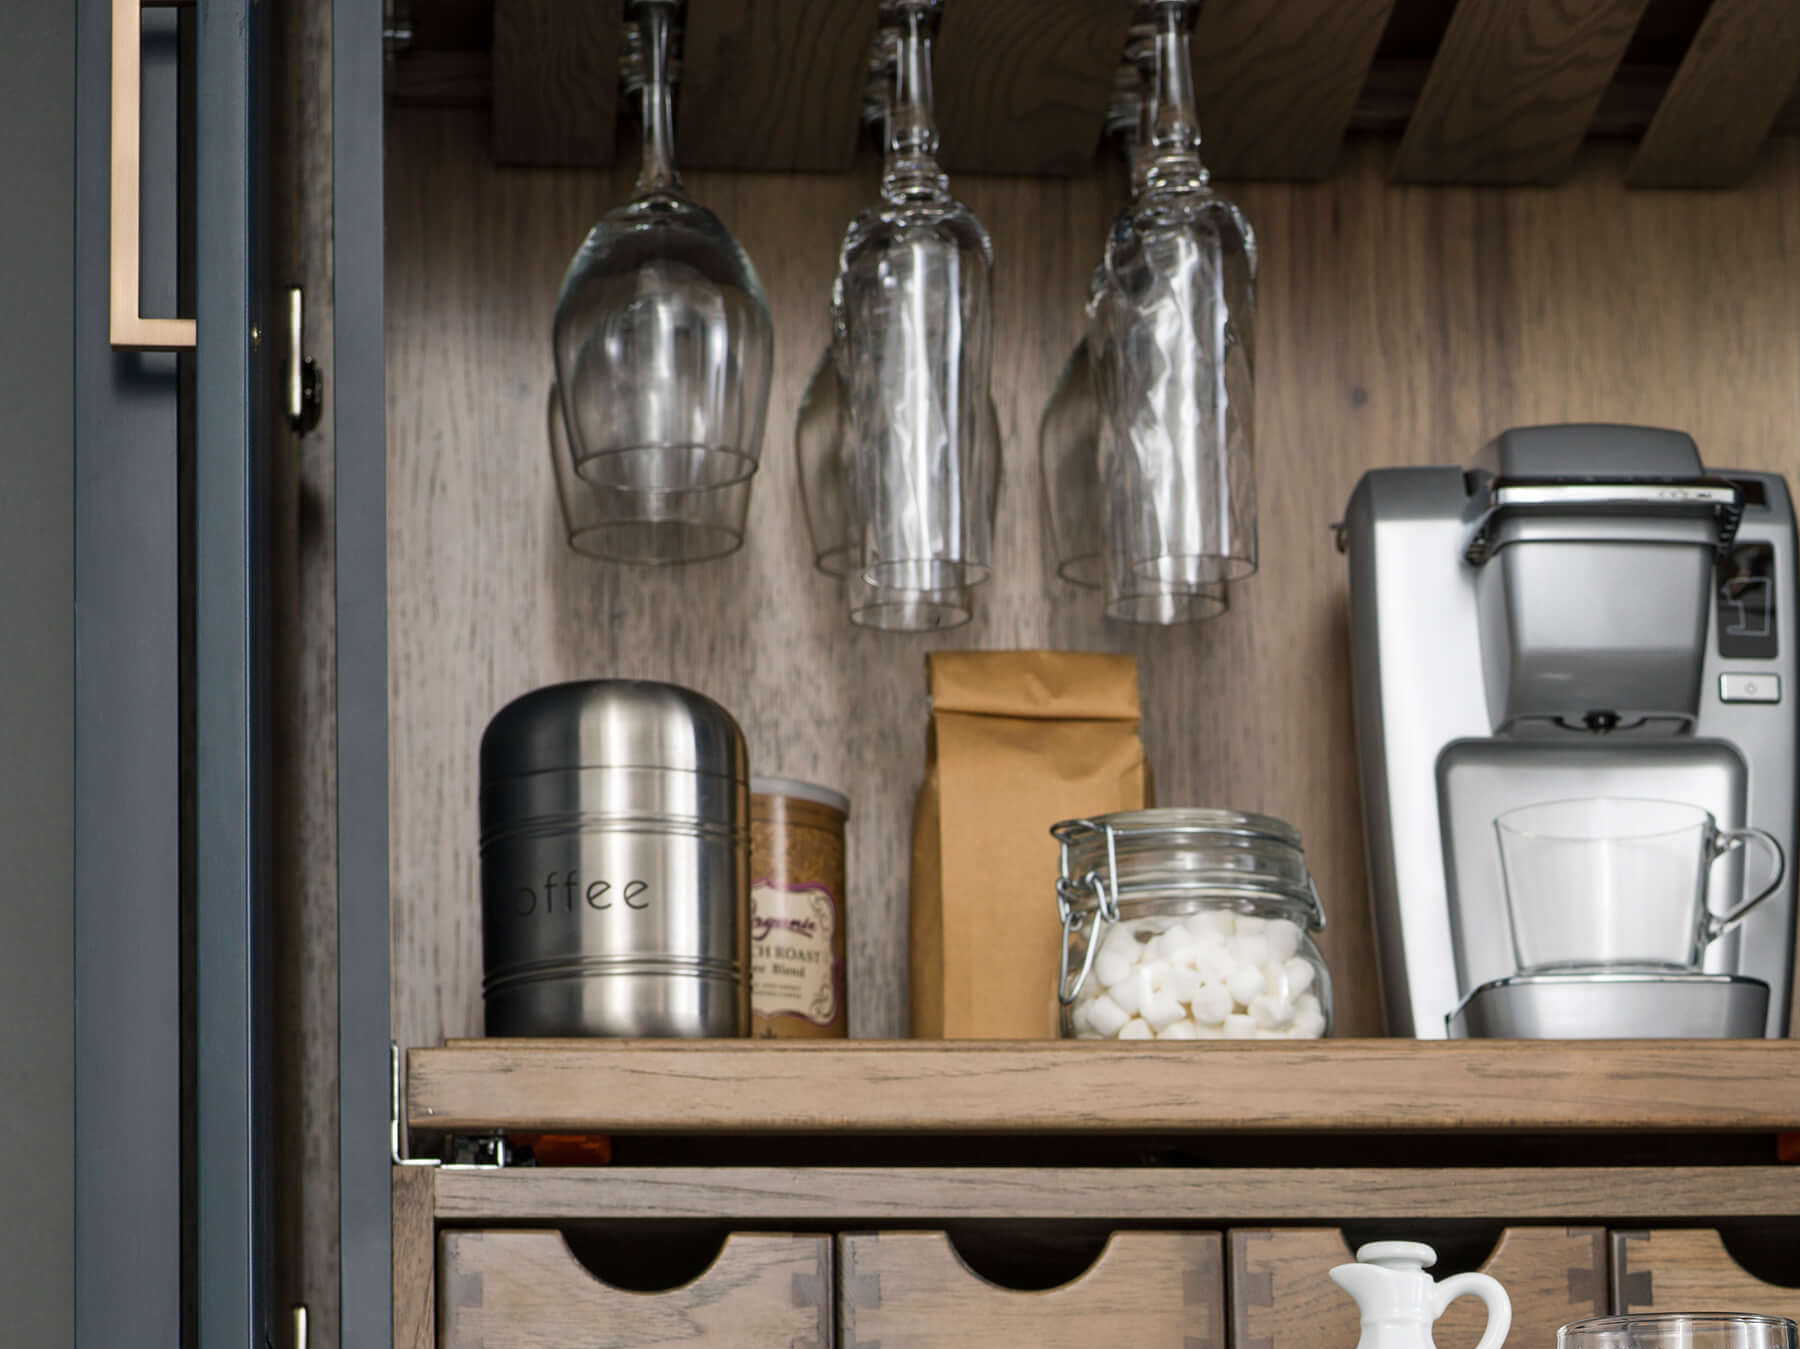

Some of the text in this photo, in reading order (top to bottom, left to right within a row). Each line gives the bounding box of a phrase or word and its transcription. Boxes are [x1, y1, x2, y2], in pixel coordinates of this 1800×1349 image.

[512, 869, 649, 918] offee
[775, 945, 820, 964] ROAST
[772, 963, 806, 978] Blend
